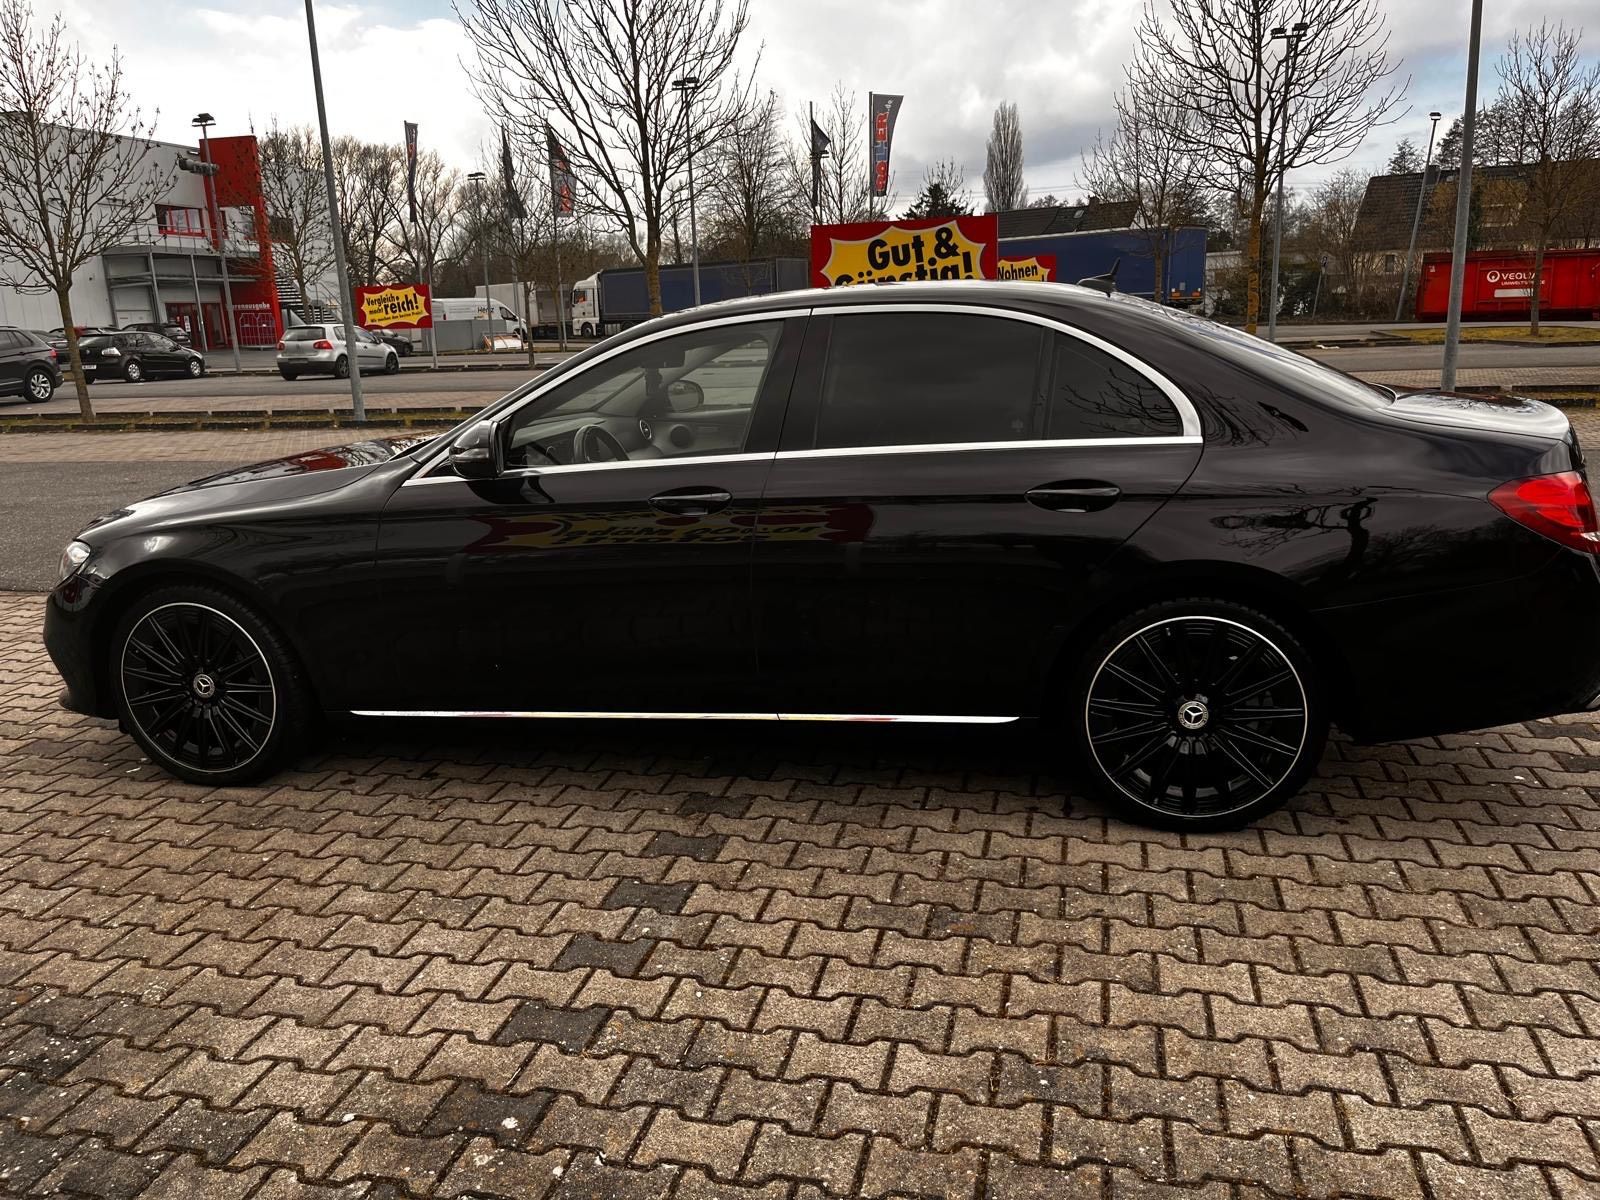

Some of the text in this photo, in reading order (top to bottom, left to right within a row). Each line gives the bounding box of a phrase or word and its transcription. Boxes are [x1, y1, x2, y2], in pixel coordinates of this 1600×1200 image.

[867, 226, 961, 271] Gut &
[1501, 272, 1536, 280] VEOL
[366, 294, 395, 307] Vergleich
[384, 293, 418, 314] reich!
